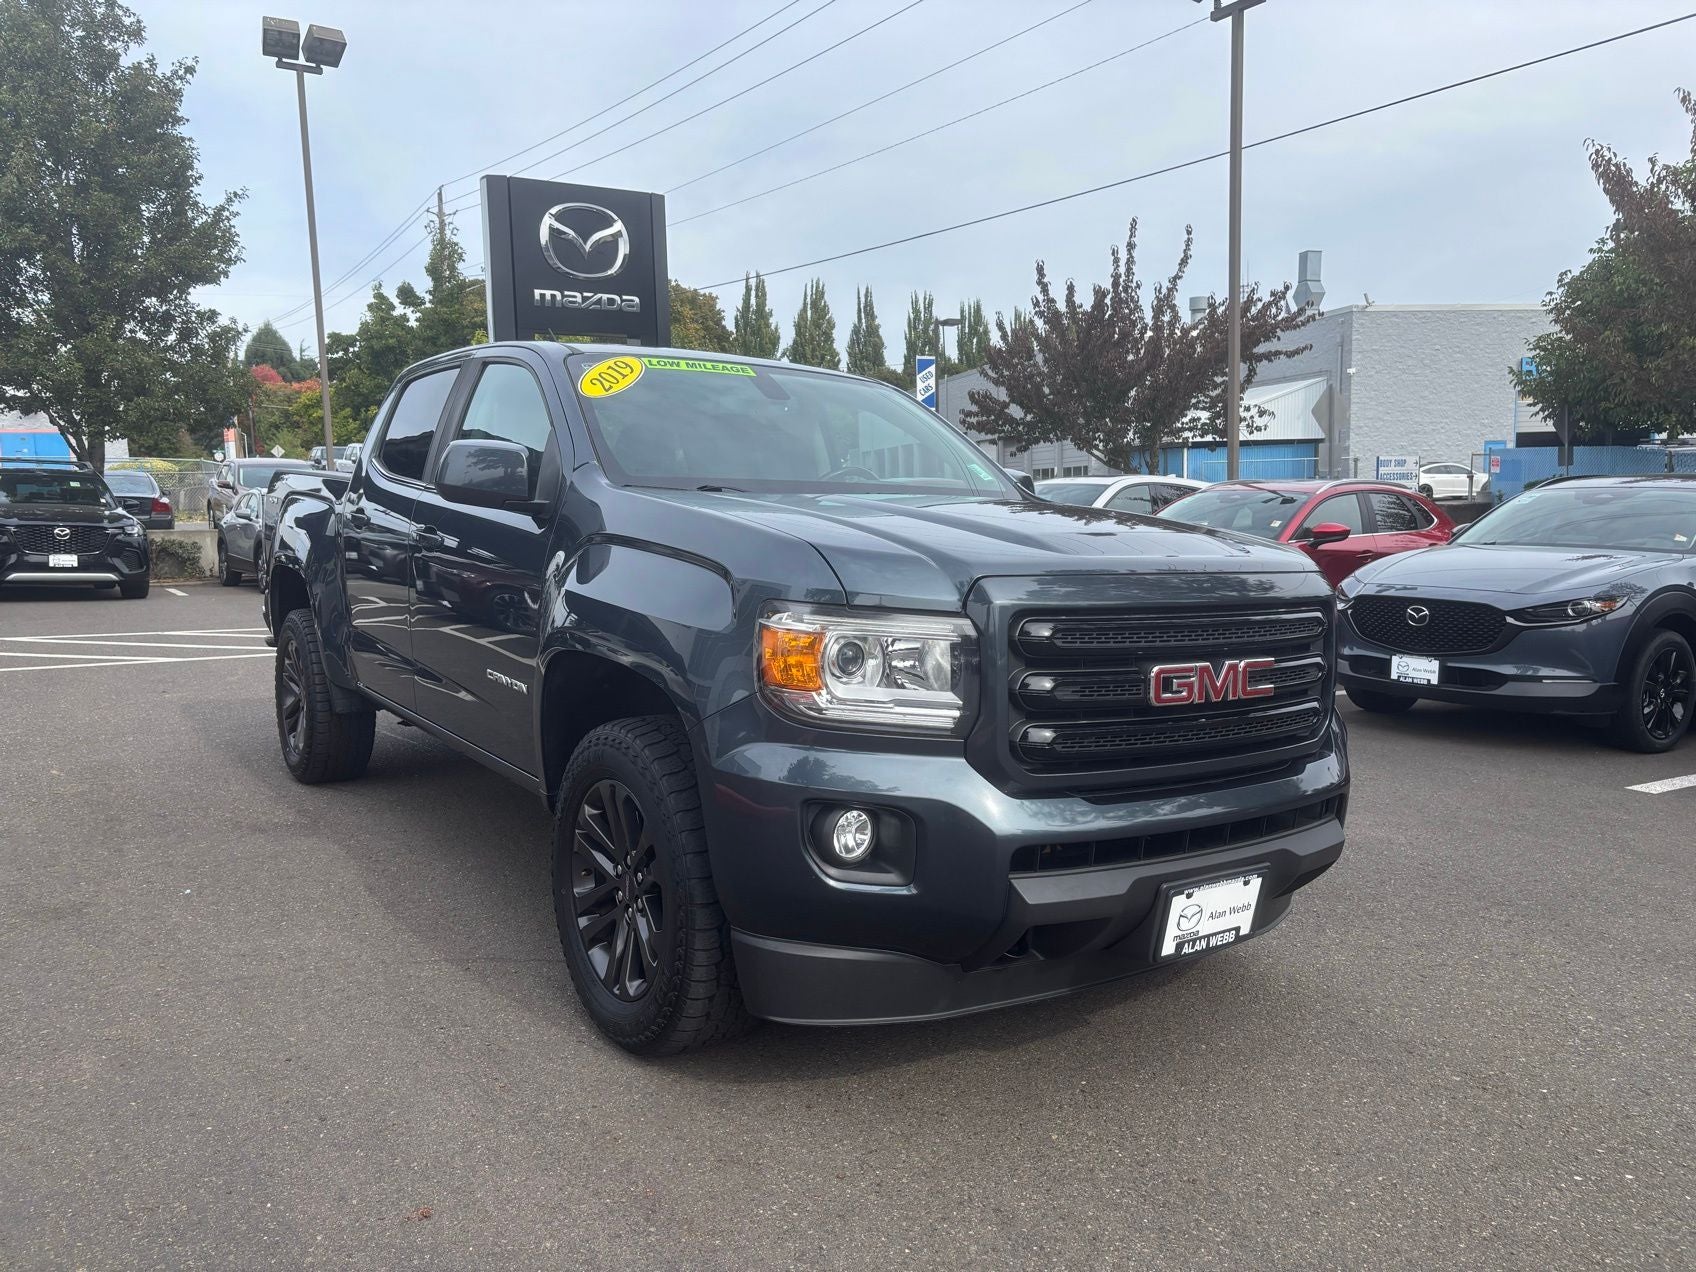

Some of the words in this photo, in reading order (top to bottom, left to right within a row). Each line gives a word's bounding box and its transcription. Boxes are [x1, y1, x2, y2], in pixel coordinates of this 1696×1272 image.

[647, 359, 681, 368] LOW
[685, 362, 751, 375] MILEAGE
[590, 359, 635, 392] 2019
[919, 370, 934, 384] USED
[919, 383, 934, 397] CARS
[1379, 459, 1392, 468] BODY
[1393, 459, 1407, 468] SHOP
[1379, 472, 1413, 480] ACCESSORIES
[486, 668, 528, 695] CANYON
[1150, 657, 1275, 707] GMC
[1399, 675, 1413, 683] ALAN
[1207, 910, 1227, 922] Alan
[1229, 901, 1252, 915] Webb
[1181, 937, 1207, 955] ALAN
[1209, 930, 1236, 948] WEBB
